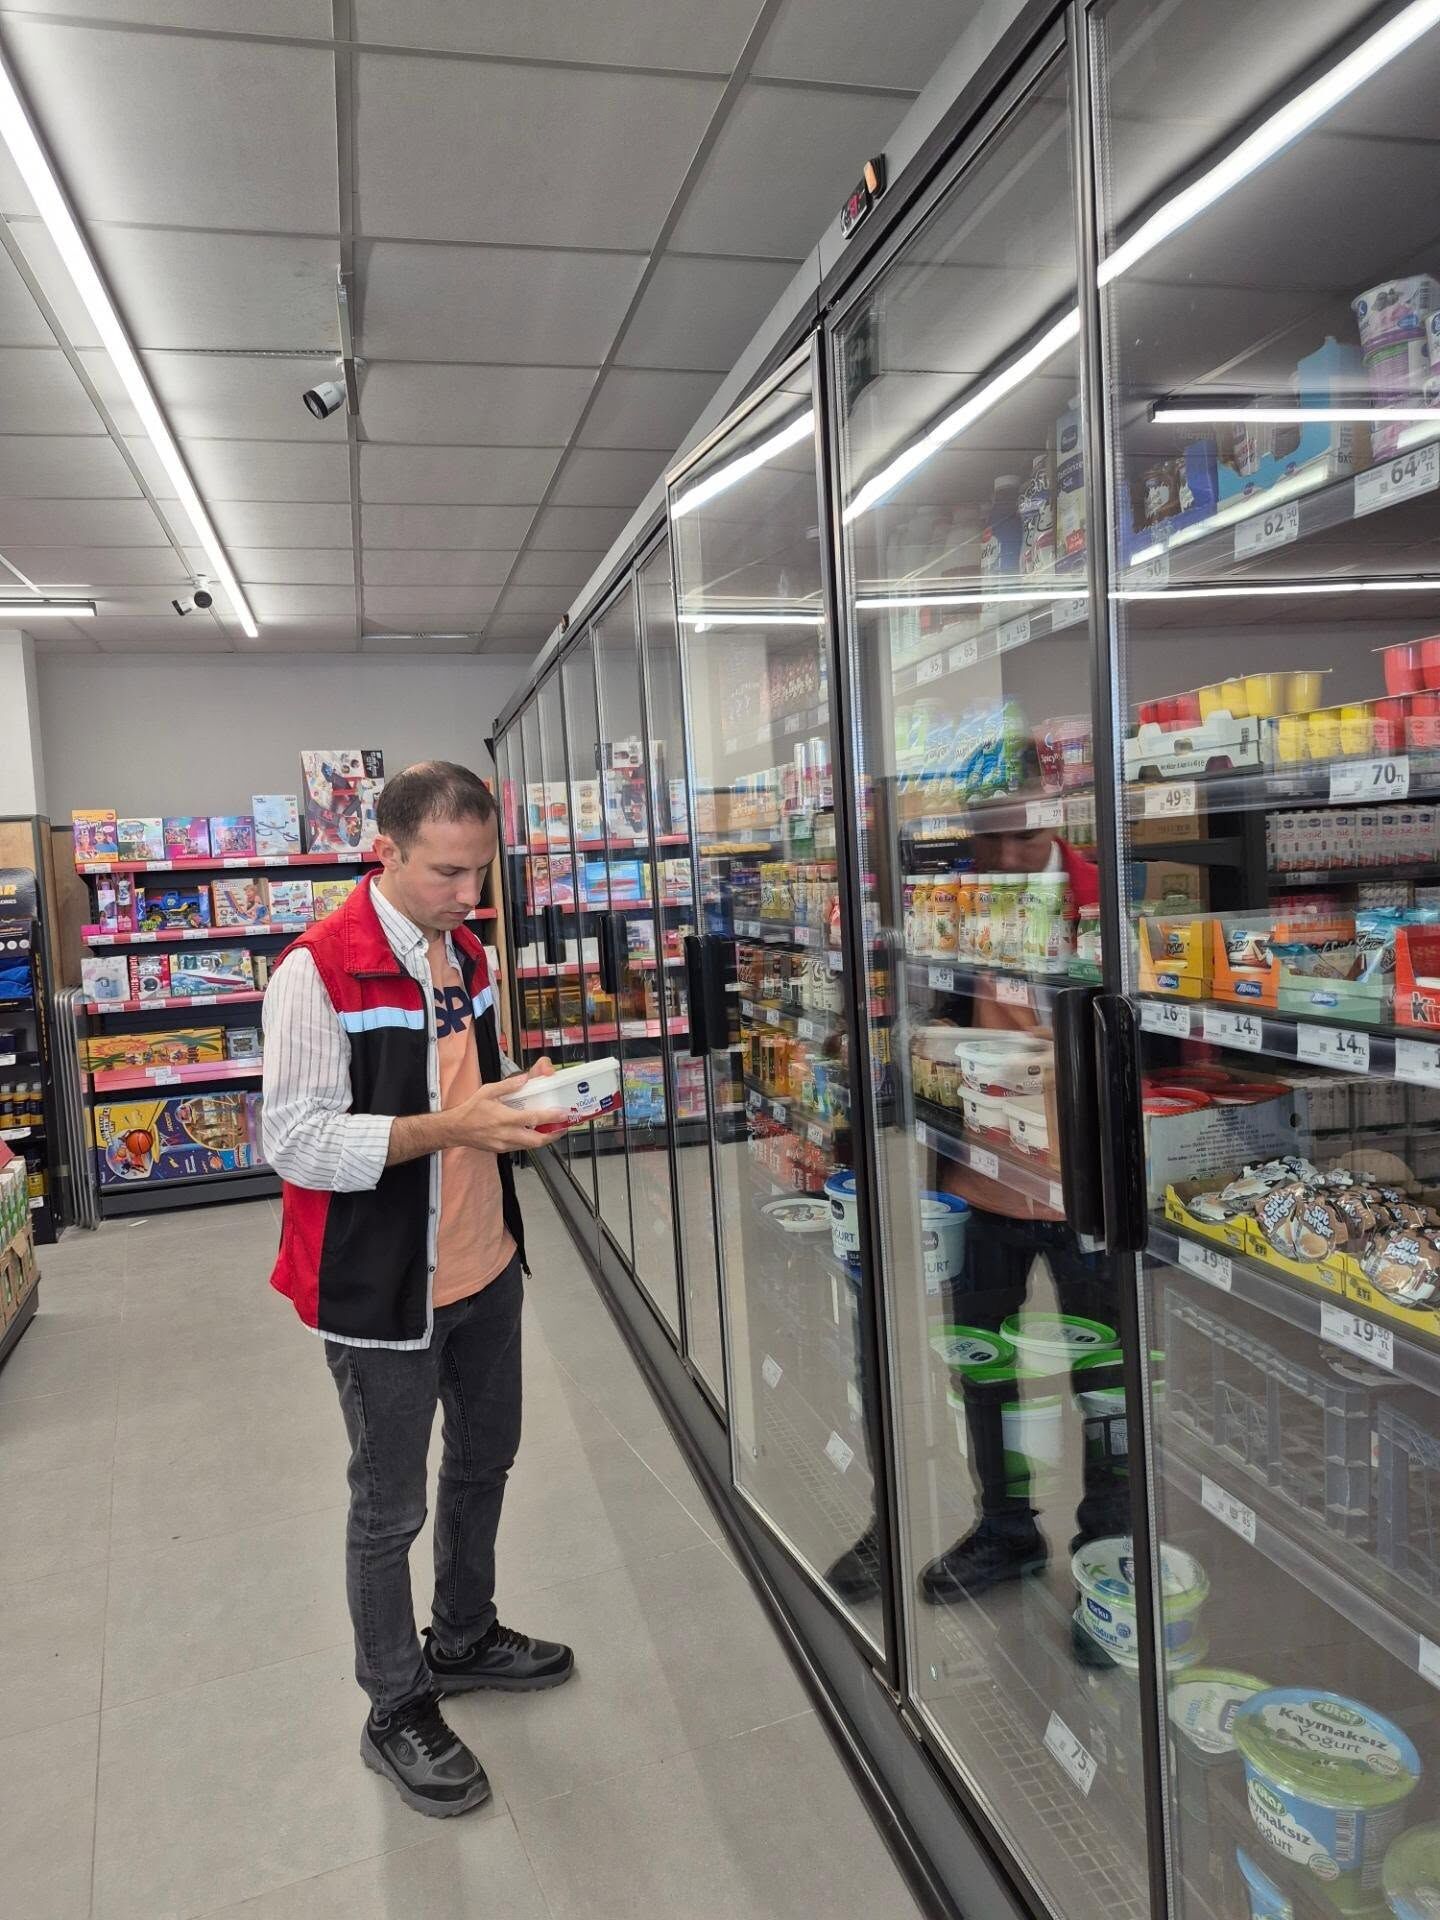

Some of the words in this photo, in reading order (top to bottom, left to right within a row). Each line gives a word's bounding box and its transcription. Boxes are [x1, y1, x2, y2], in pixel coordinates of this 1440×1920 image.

[1372, 762, 1396, 785] 70
[1234, 1015, 1254, 1035] 14
[1335, 1032, 1358, 1053] 14
[1279, 1707, 1389, 1751] Kaymaksız
